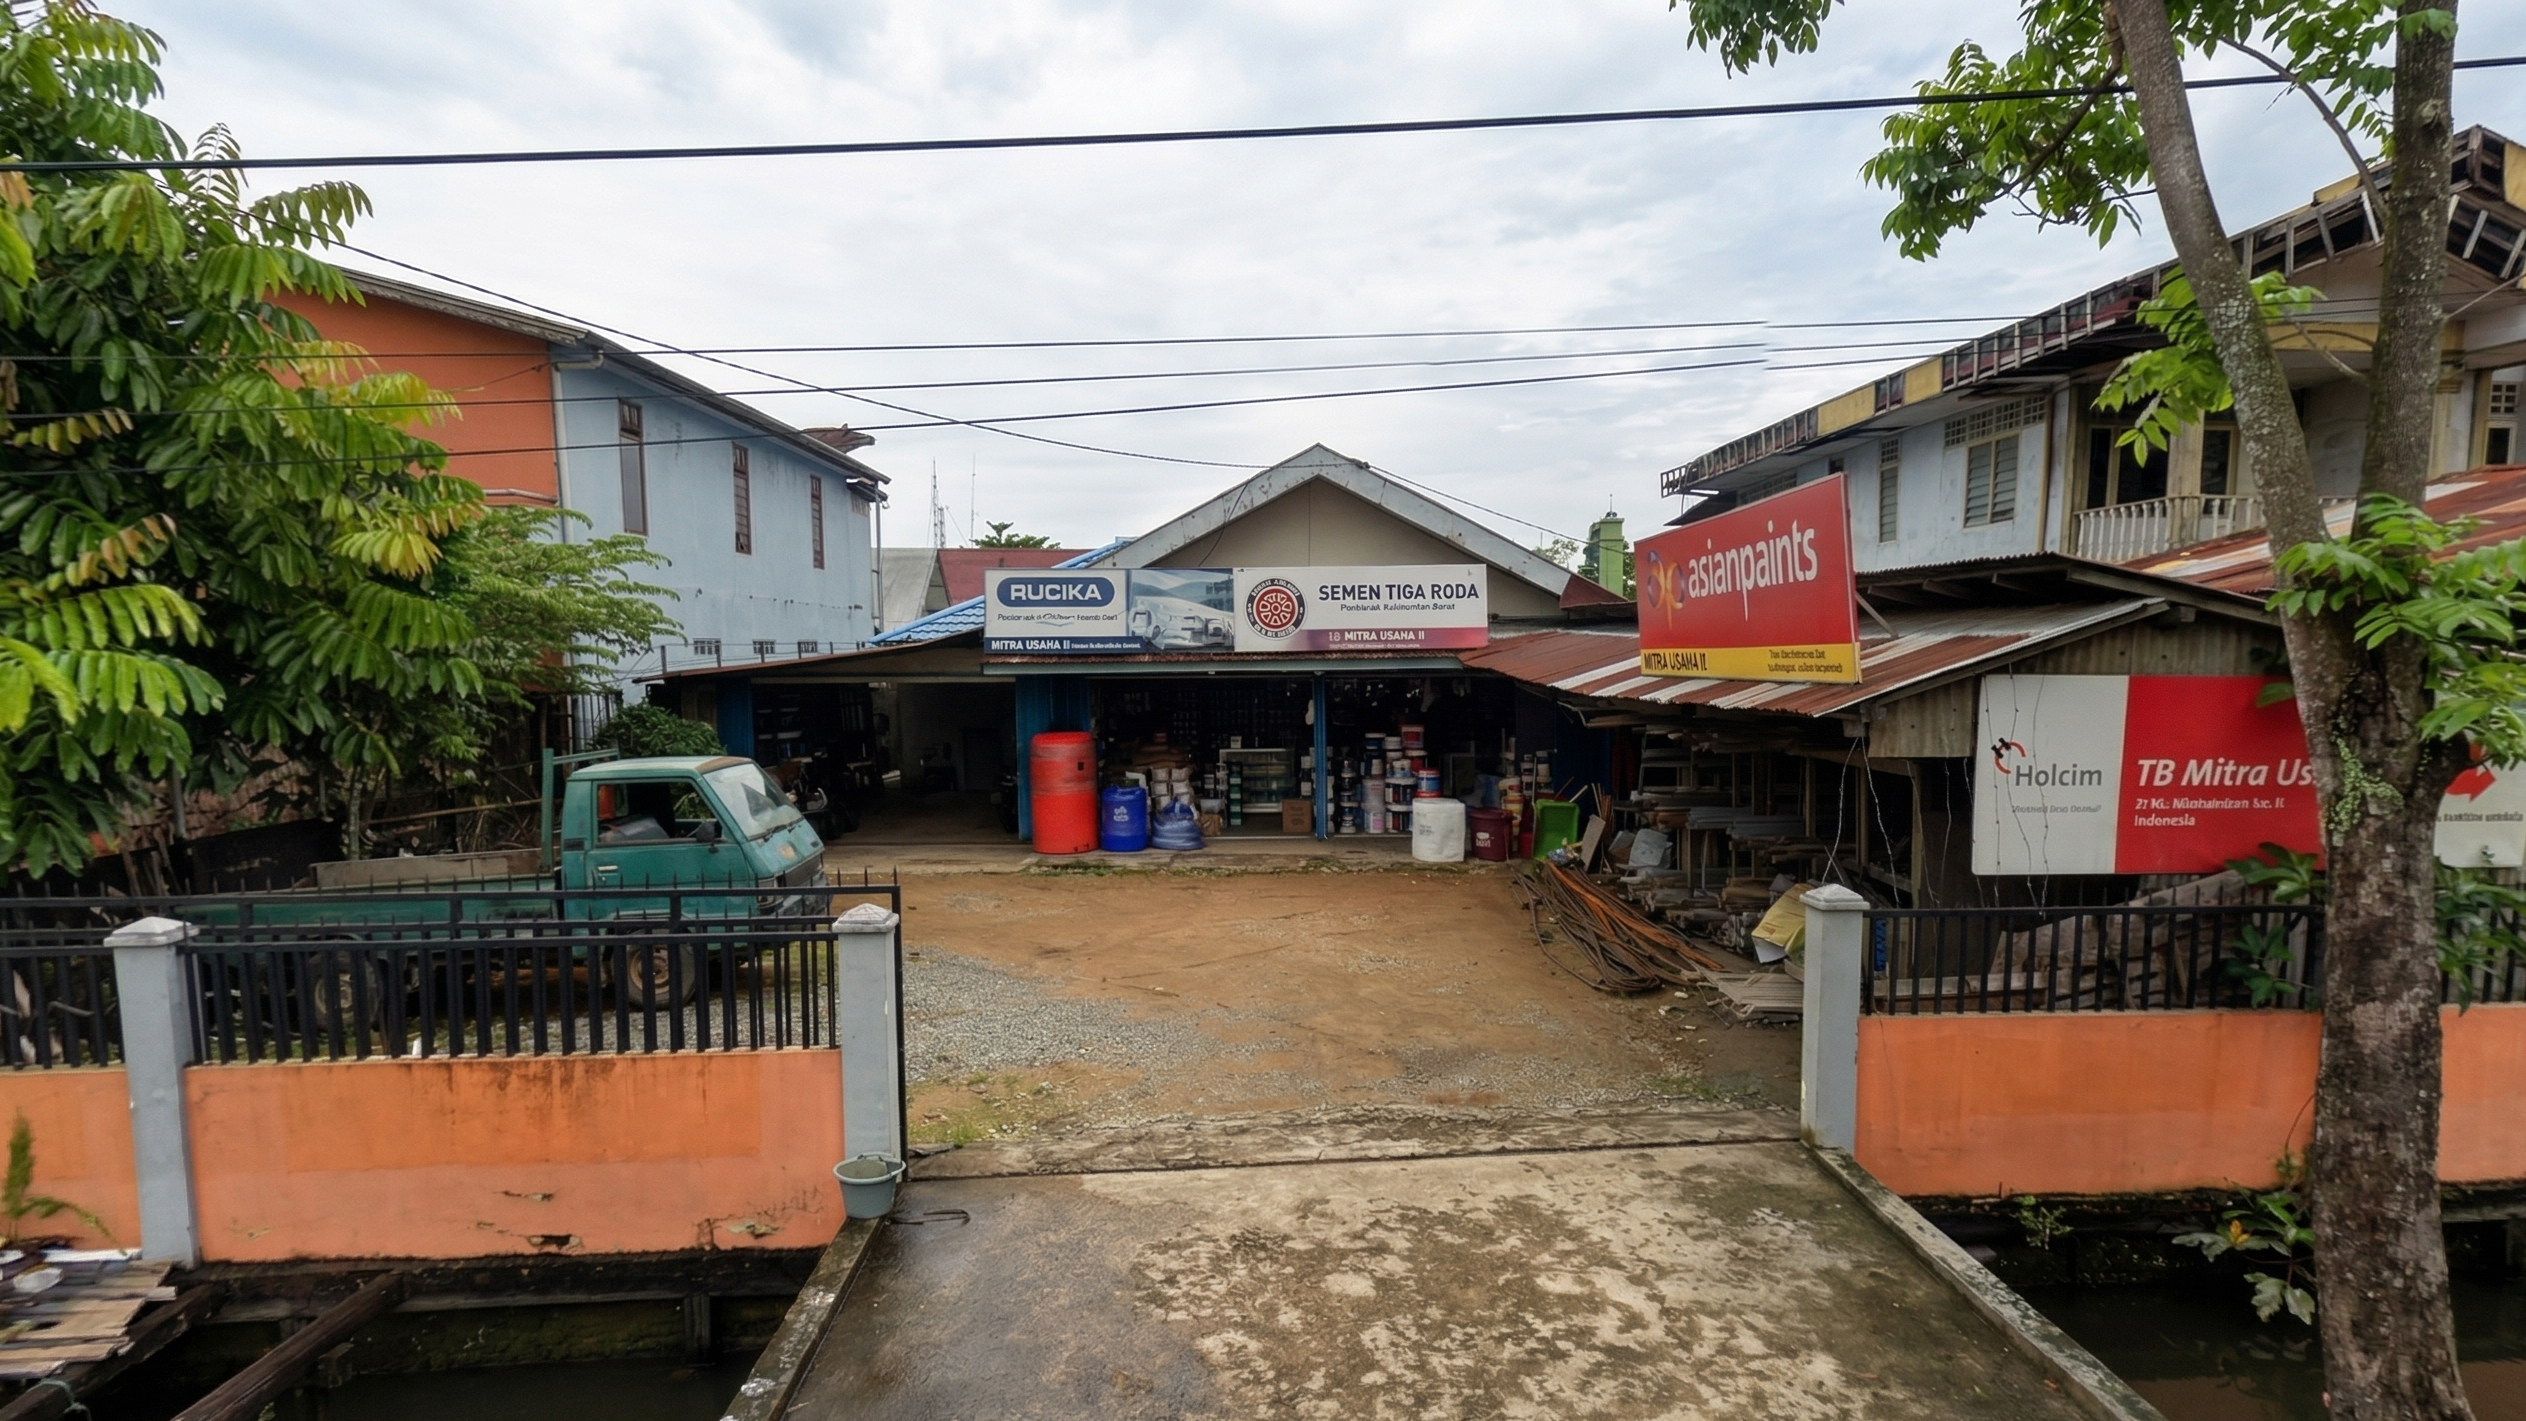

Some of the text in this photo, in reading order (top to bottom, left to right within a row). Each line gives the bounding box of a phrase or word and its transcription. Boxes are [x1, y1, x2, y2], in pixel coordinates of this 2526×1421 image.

[1687, 519, 1818, 622] asianpaints
[1010, 583, 1102, 601] RUCIKA
[1319, 584, 1381, 601] SEMEN
[1385, 584, 1426, 600] TIGA
[1431, 583, 1480, 600] RODA
[1344, 631, 1378, 641] MITRA
[1380, 630, 1416, 640] USAHA
[991, 640, 1024, 650] MITRA
[1026, 640, 1061, 650] USAHA
[2015, 763, 2102, 786] Holcim
[2137, 757, 2317, 787] TB Mitra Us
